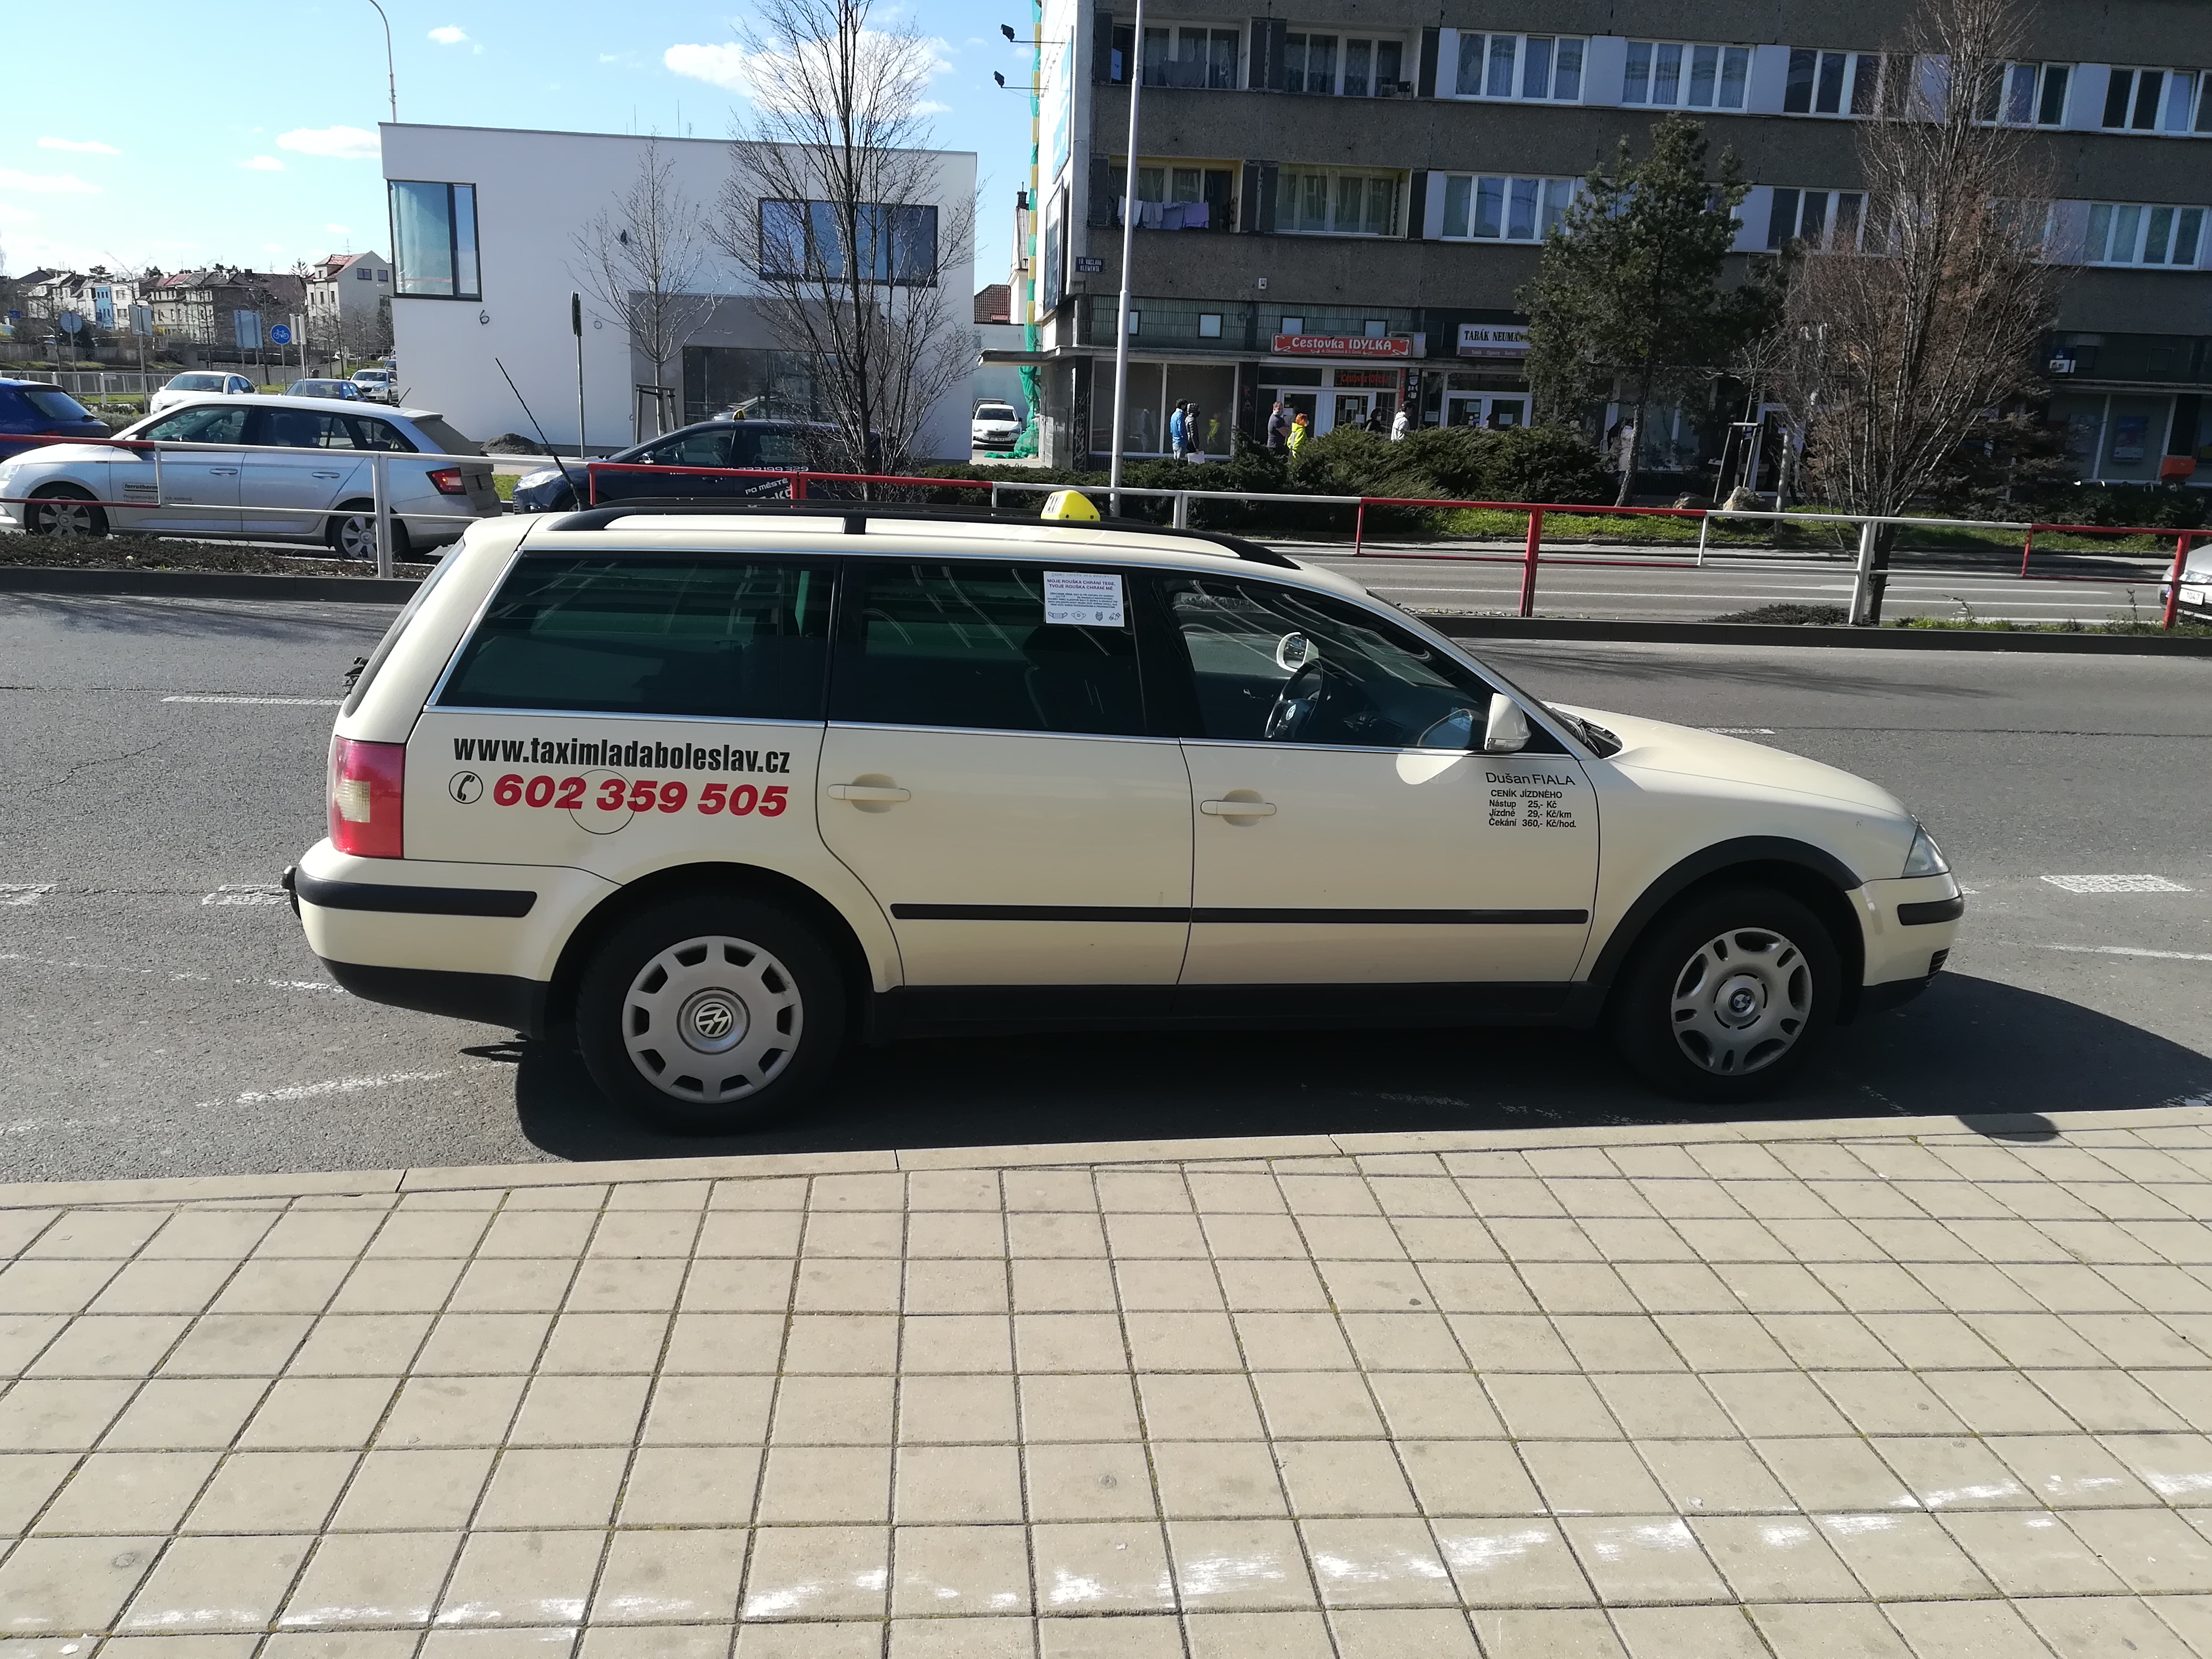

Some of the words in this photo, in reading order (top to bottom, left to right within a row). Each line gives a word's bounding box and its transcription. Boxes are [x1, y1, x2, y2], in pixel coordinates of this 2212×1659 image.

[1464, 328, 1490, 341] TABÁK
[1492, 331, 1522, 342] NEUMA
[1292, 337, 1344, 349] Cestovka
[1348, 338, 1391, 351] IDYLKA
[2186, 591, 2200, 600] 1047
[453, 737, 790, 774] www.taximladaboleslav.cz
[1485, 772, 1530, 784] Dušan
[1531, 774, 1576, 785] FIALA
[493, 773, 587, 809] 602
[596, 778, 688, 813] 359
[697, 782, 789, 817] 505
[1491, 788, 1517, 798] CENÍK
[1520, 789, 1563, 798] JÍZDNÉHO
[1489, 799, 1516, 809] Nástup
[1527, 801, 1543, 809] 25,-
[1527, 810, 1543, 819] 29,-
[1546, 810, 1571, 818] Kč/km
[1488, 817, 1517, 827] Čekání
[1522, 819, 1543, 828] 360,-
[1546, 819, 1576, 828] Kč/hod.
